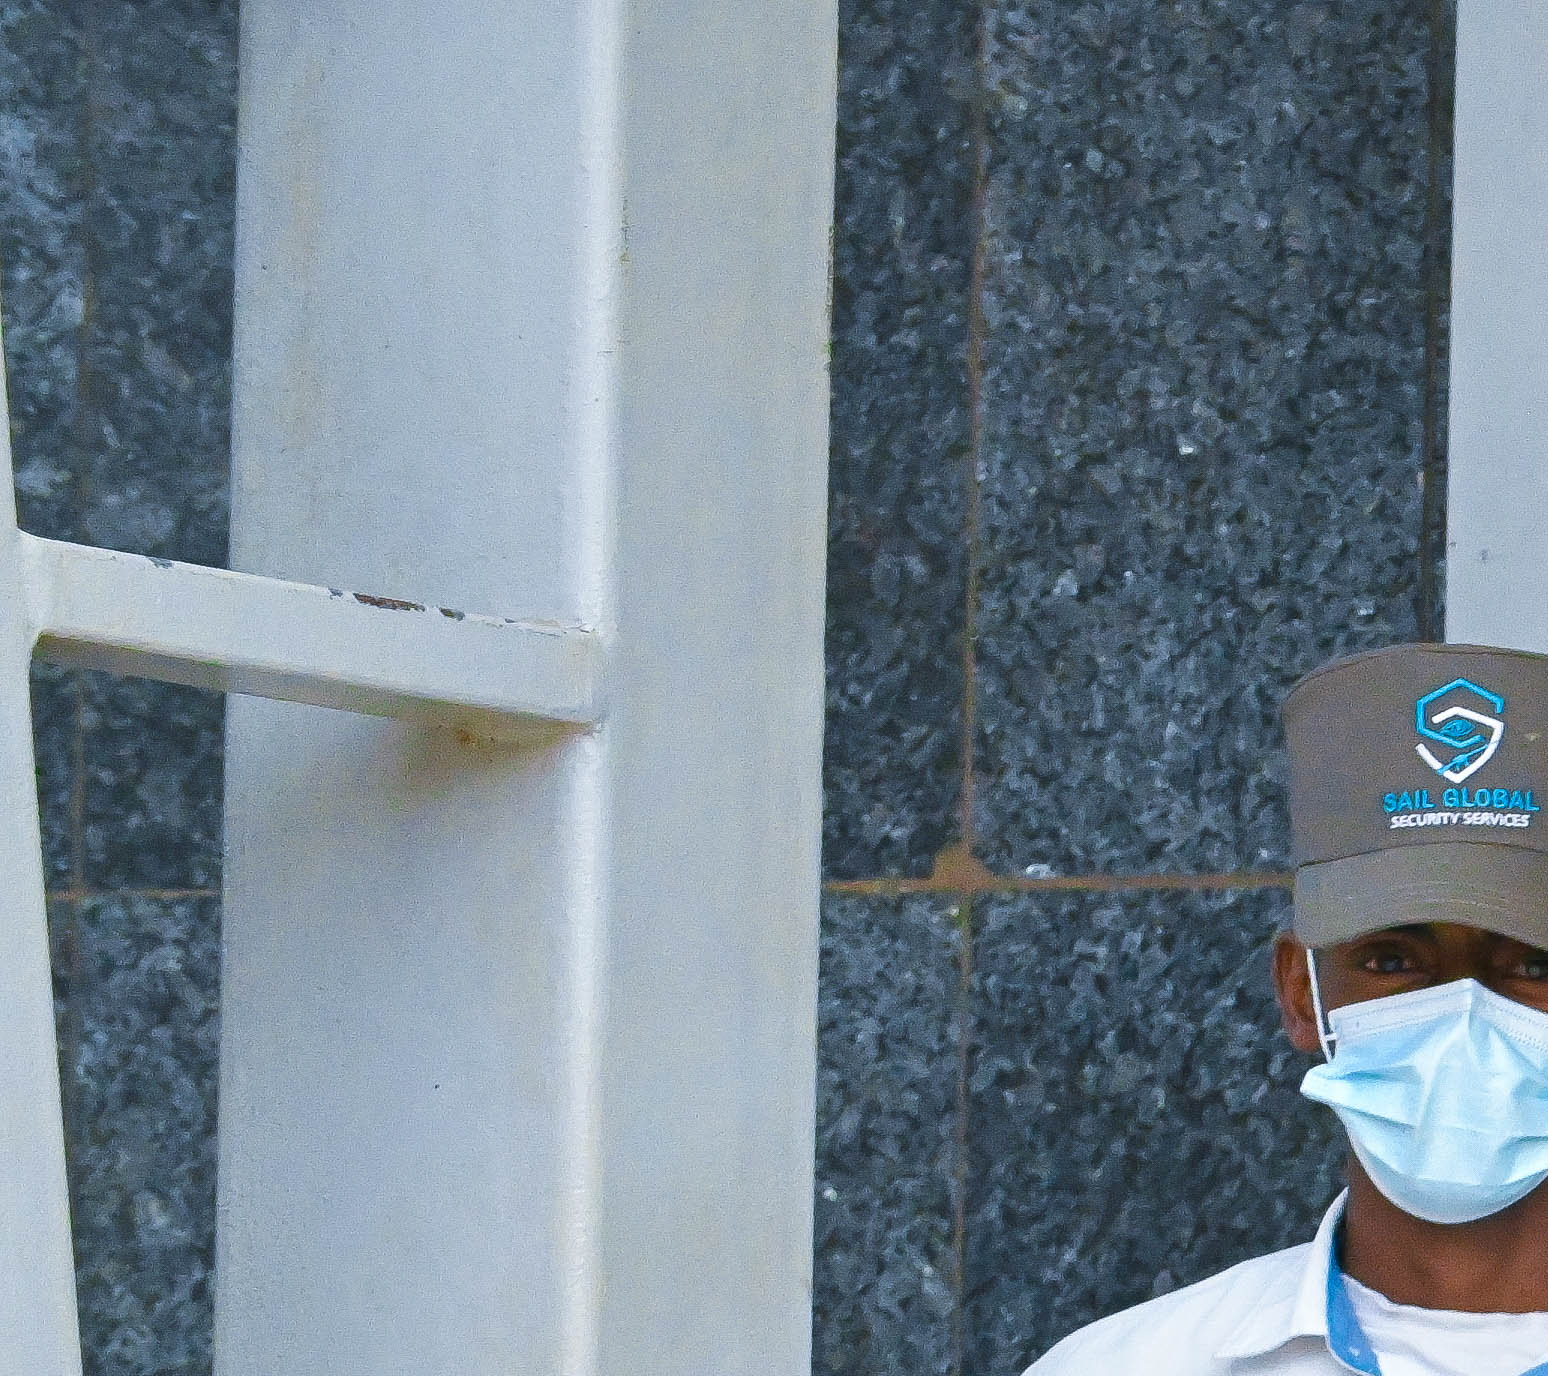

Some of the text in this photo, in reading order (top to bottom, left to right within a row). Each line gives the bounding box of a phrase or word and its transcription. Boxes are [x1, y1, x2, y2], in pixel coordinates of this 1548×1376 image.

[1384, 787, 1540, 812] SAIL GLOBAL
[1390, 812, 1530, 829] SECURITY SERVICES
